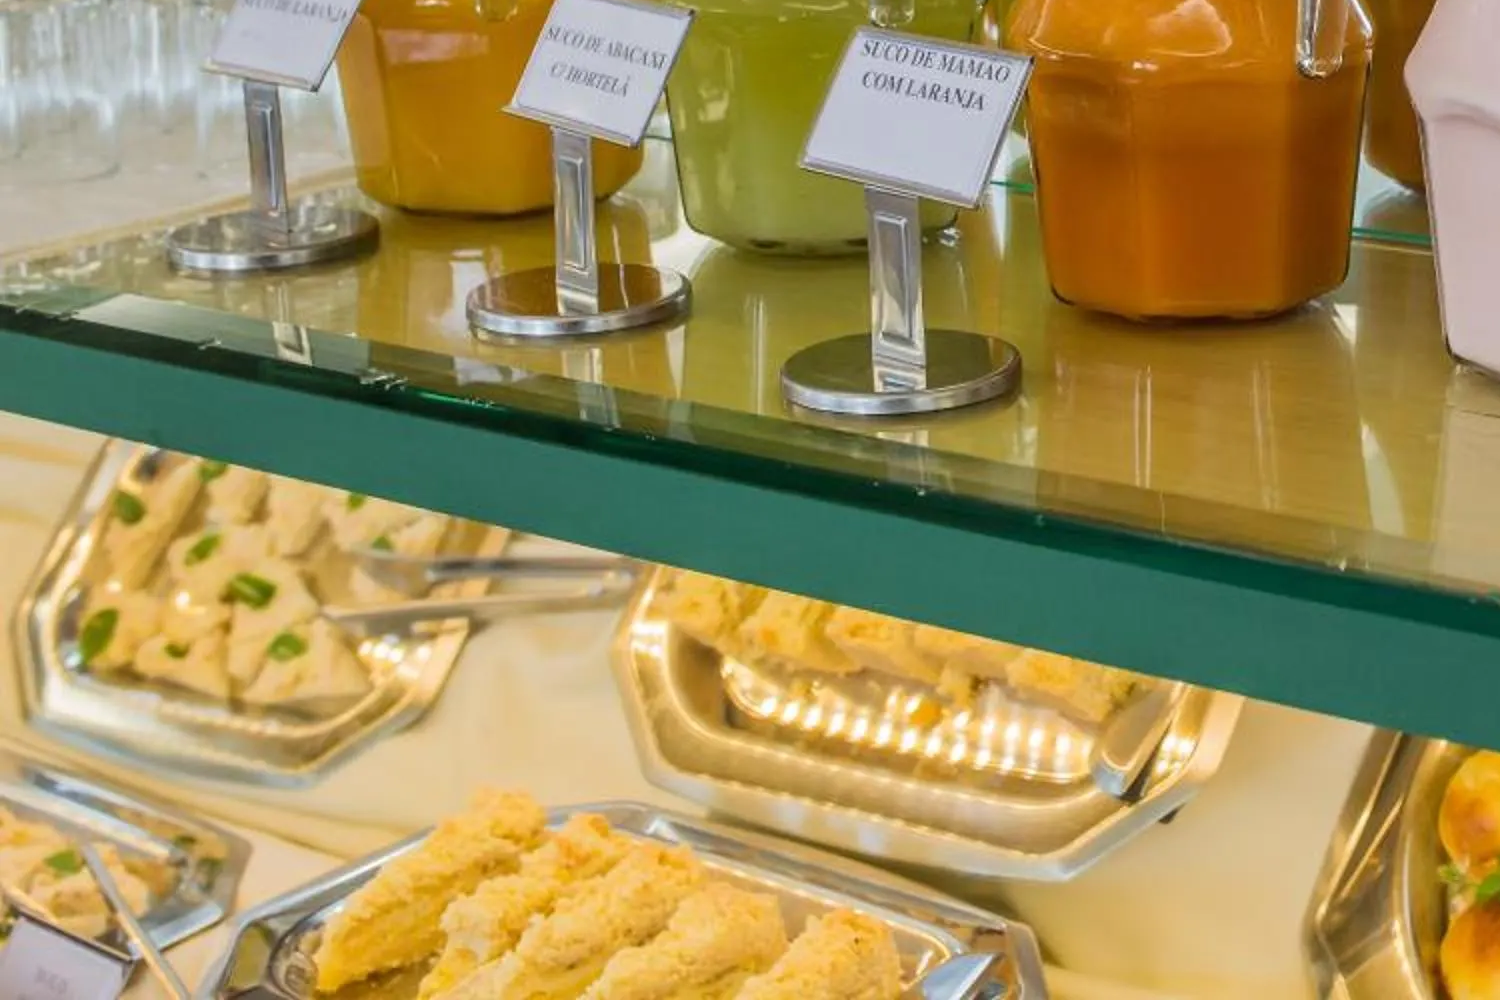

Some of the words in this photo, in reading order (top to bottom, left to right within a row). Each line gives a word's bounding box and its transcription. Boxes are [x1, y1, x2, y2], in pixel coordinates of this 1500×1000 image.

[862, 39, 909, 63] SUCO
[911, 48, 937, 68] DE
[862, 71, 905, 94] COM
[905, 78, 986, 111] LARANJA
